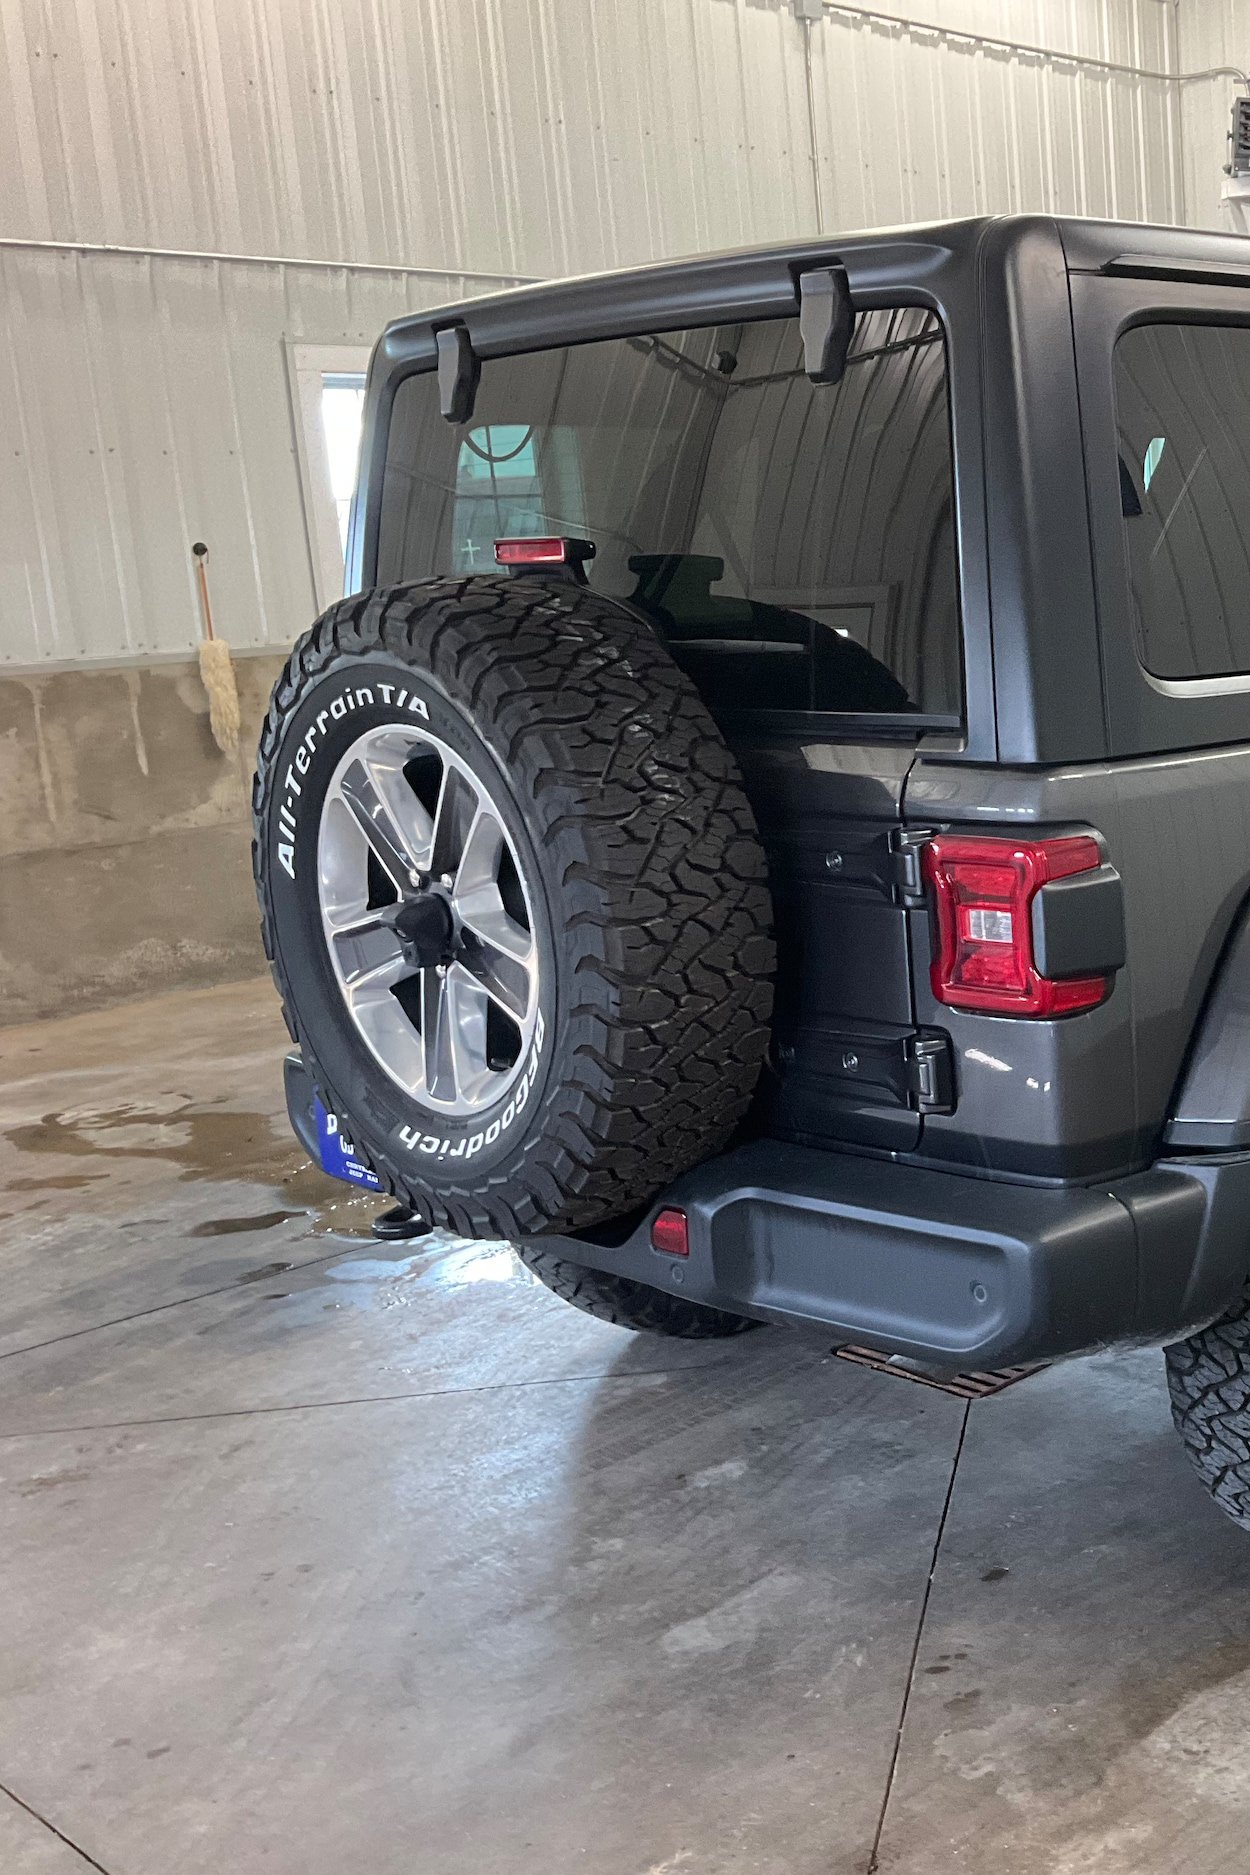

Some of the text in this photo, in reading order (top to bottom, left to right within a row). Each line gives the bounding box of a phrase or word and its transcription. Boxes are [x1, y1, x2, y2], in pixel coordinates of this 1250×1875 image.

[278, 684, 430, 880] All-Terrain T/A
[399, 1007, 545, 1161] BFGoodrich
